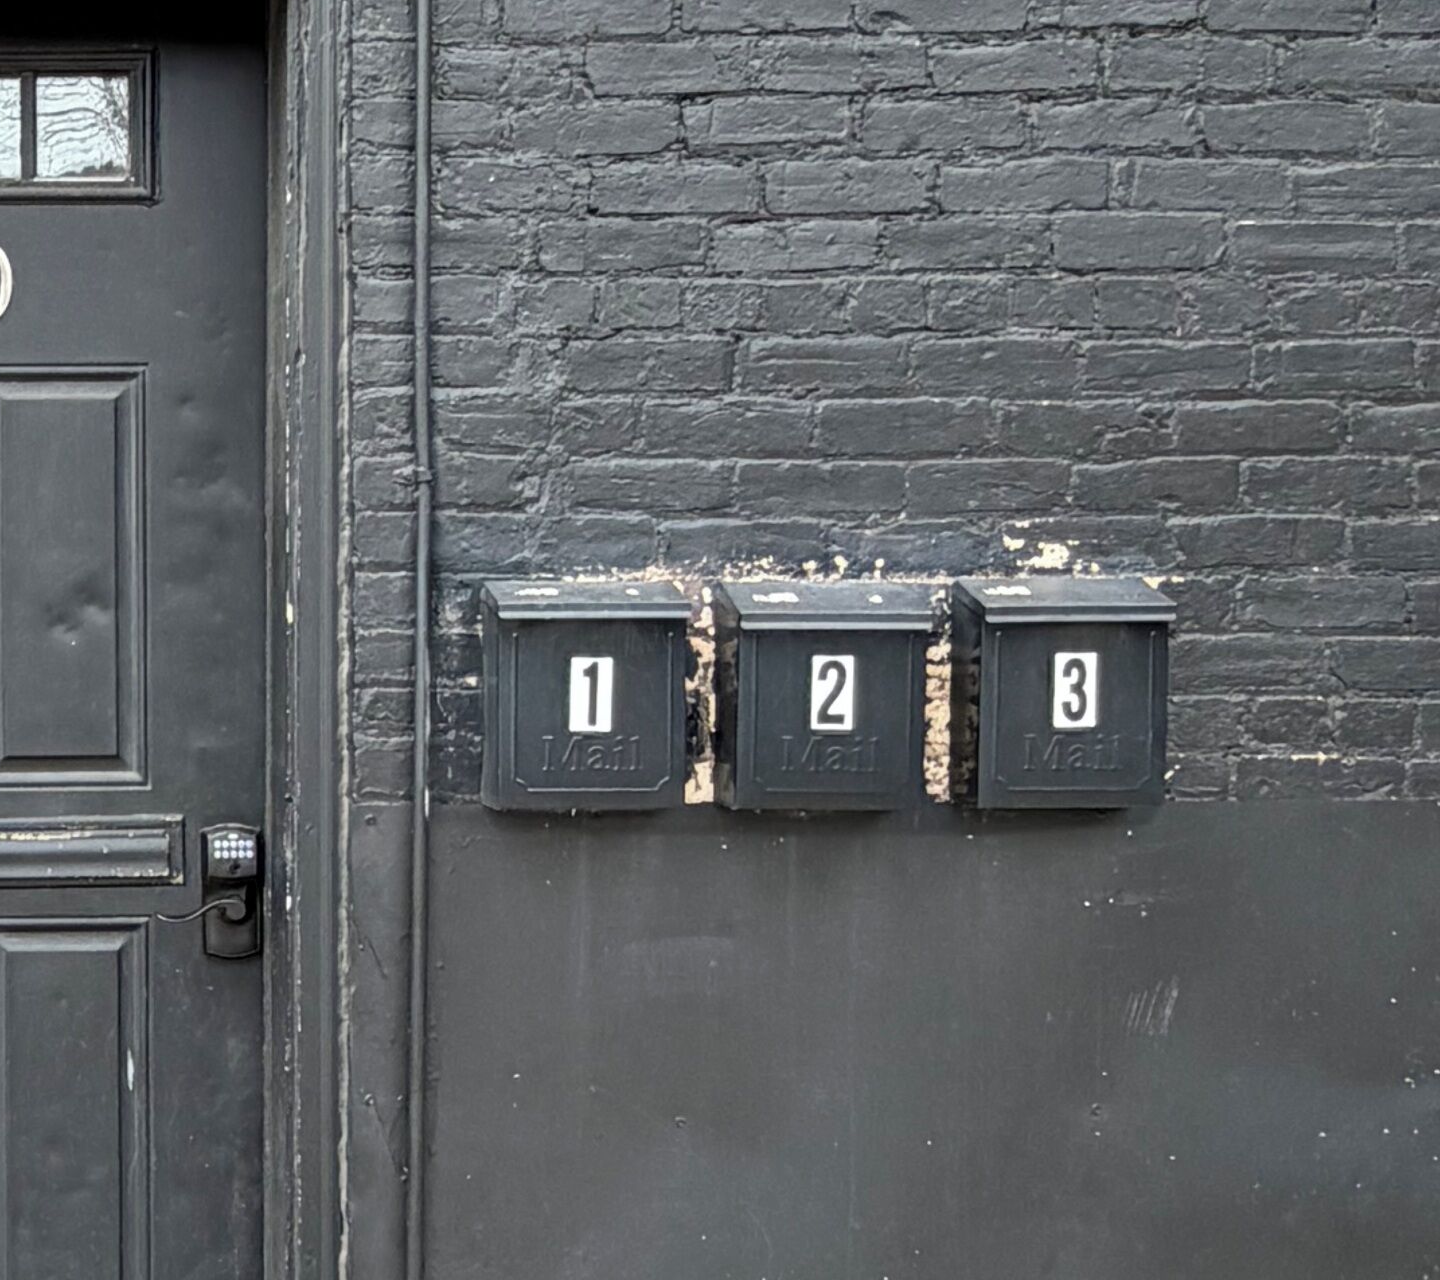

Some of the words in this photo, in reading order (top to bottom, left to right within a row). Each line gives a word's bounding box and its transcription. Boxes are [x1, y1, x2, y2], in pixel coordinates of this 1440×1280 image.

[582, 660, 600, 727] 1
[816, 659, 847, 725] 2
[1061, 657, 1088, 723] 3
[541, 735, 644, 771] Mail
[780, 735, 881, 771] Mail
[1024, 733, 1124, 770] Mail
